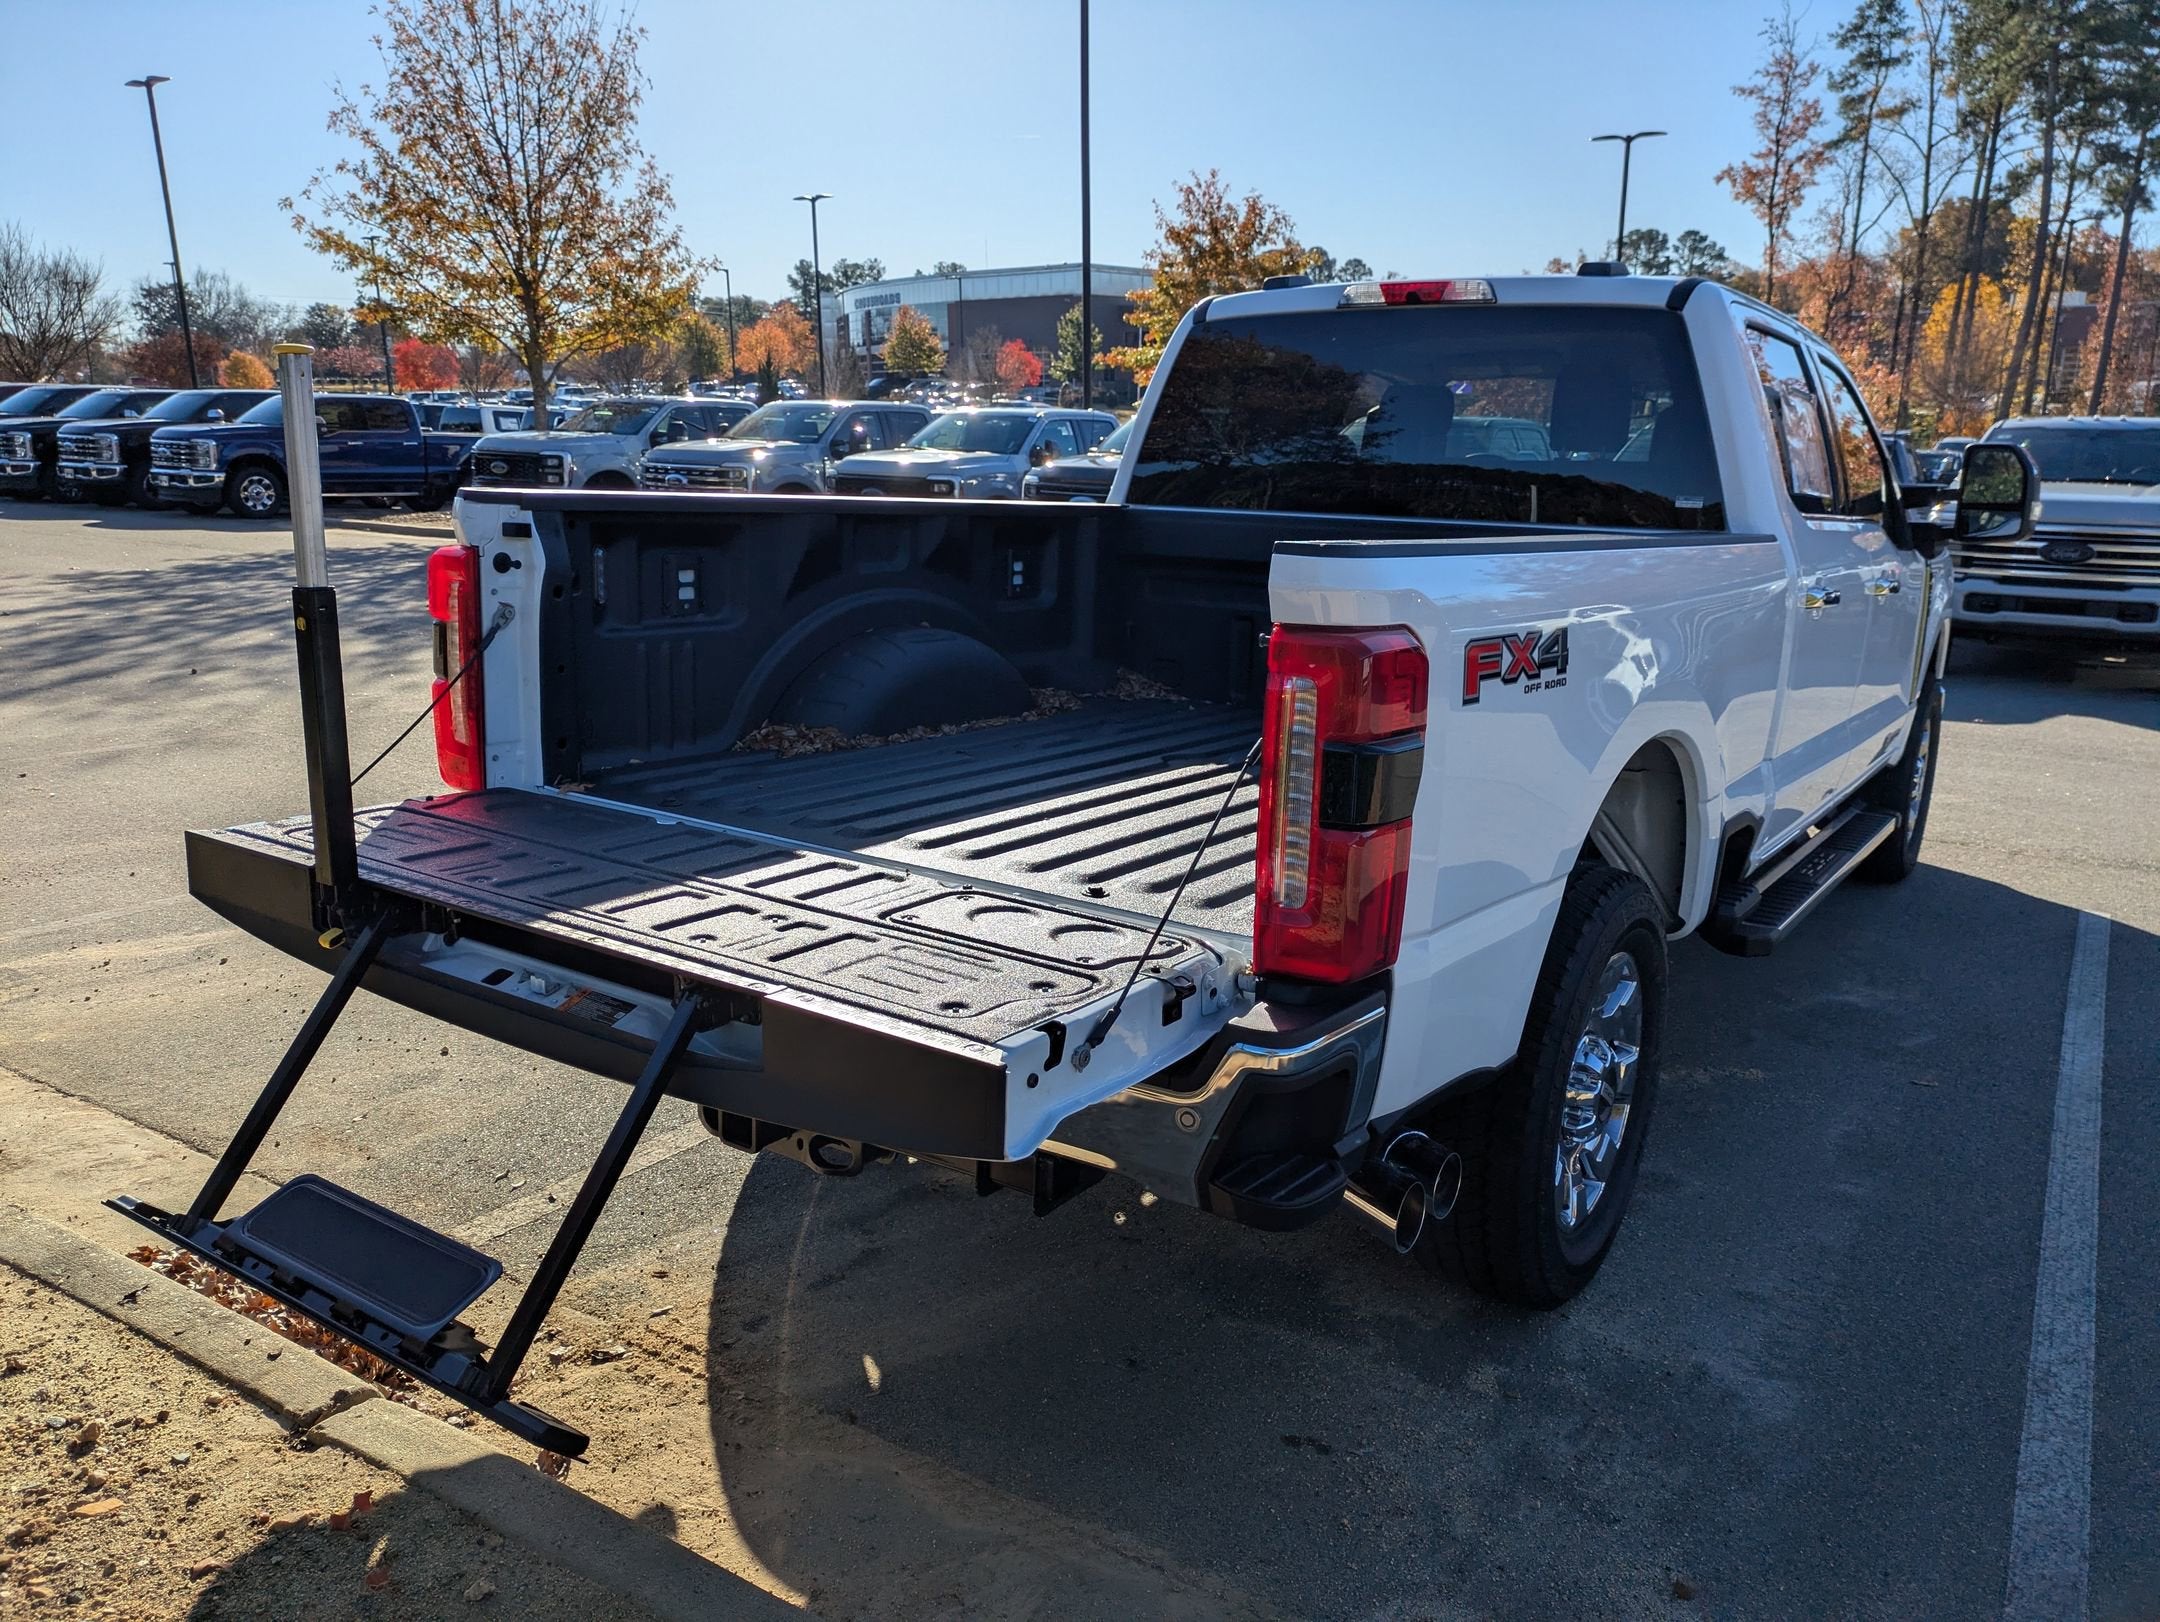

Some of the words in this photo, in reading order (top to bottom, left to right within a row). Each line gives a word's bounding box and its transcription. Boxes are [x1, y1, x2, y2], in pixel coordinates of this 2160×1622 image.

[1462, 627, 1569, 706] FX4
[1524, 683, 1542, 694] OFF
[1544, 678, 1567, 690] ROAD
